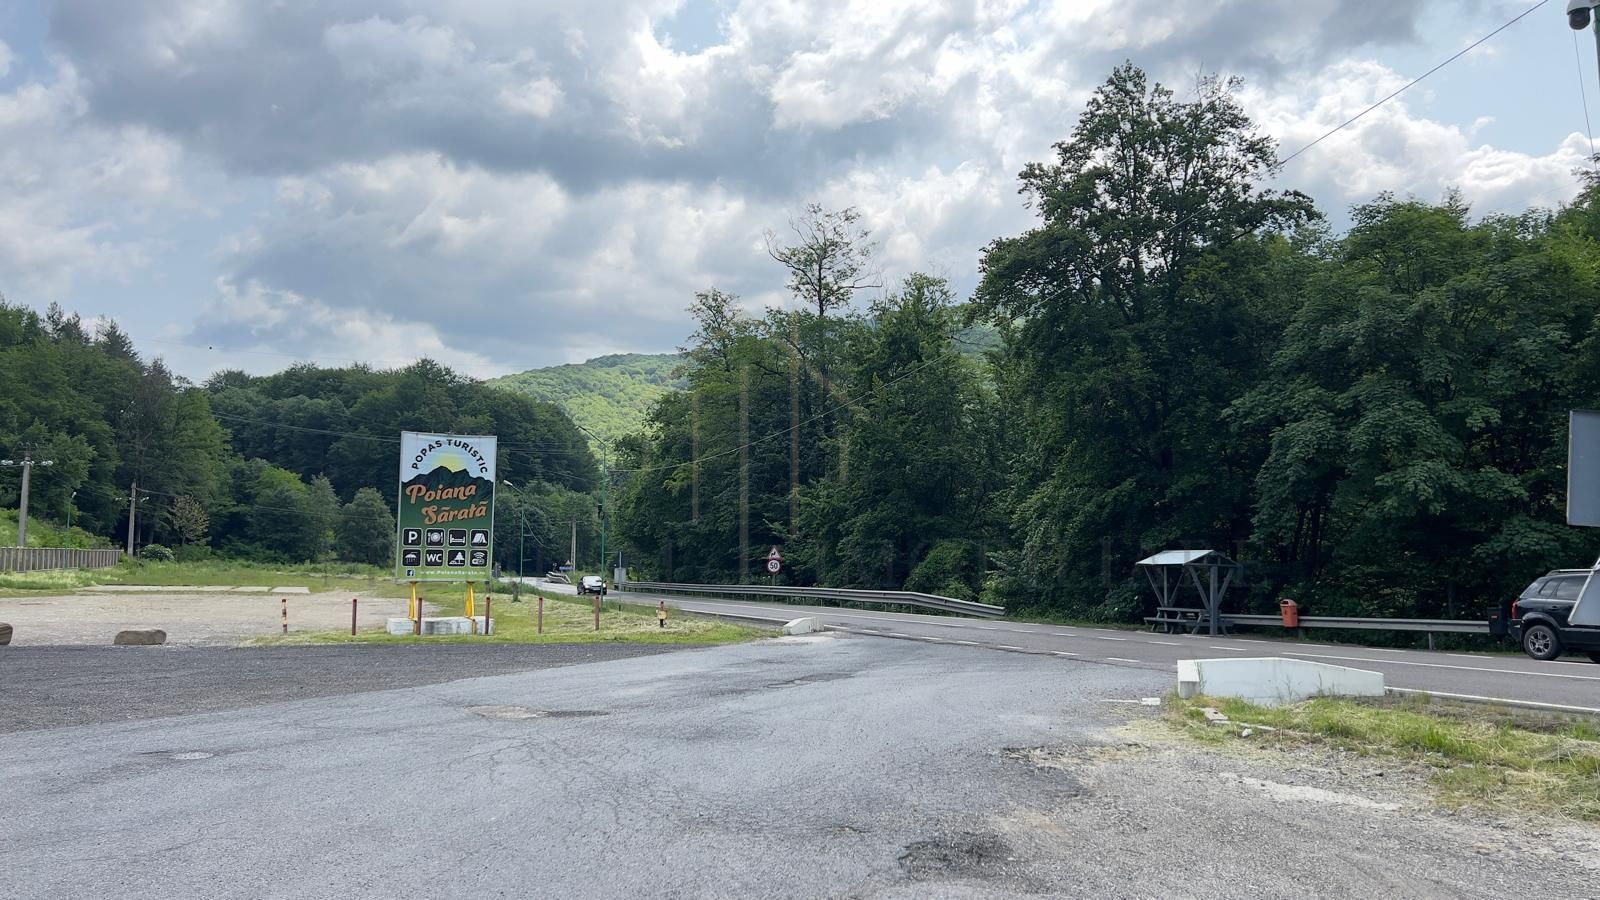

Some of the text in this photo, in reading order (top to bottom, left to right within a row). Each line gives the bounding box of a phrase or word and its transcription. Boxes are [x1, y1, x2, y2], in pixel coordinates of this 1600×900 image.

[411, 439, 488, 473] POPAS TURISTIC
[405, 484, 477, 504] Poiana
[408, 531, 418, 544] P
[426, 553, 442, 563] WC
[769, 562, 779, 570] 50
